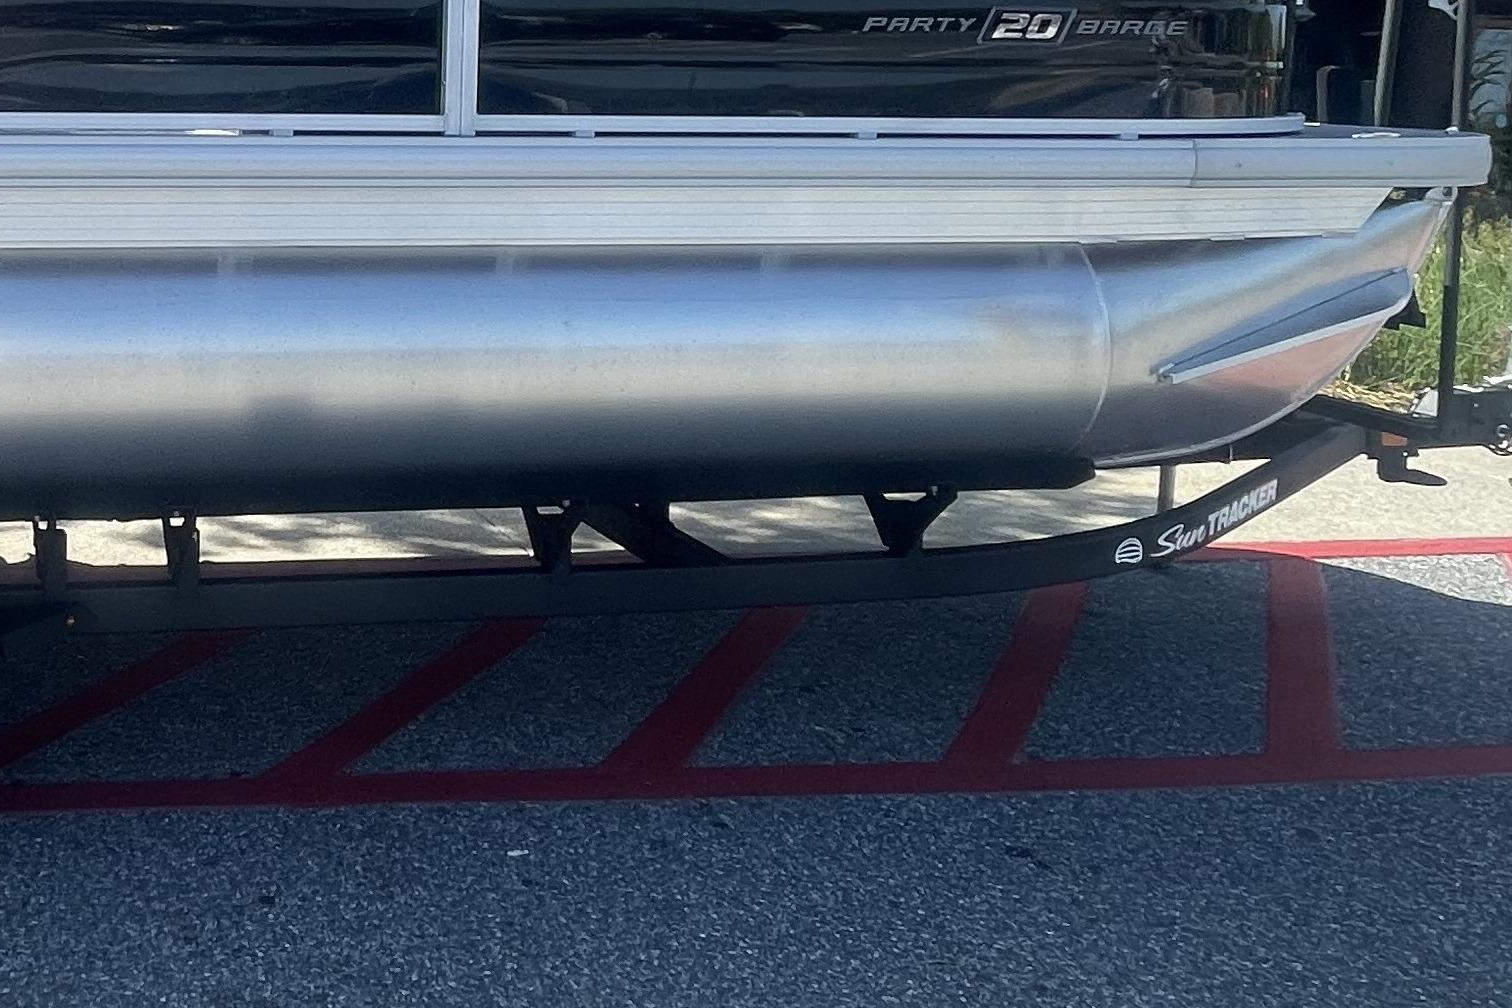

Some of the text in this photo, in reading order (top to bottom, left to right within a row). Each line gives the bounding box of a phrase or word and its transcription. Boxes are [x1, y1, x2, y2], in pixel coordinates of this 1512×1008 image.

[862, 12, 1190, 40] PARTY 20 BARGE
[1149, 478, 1279, 558] Sun TRACKER
